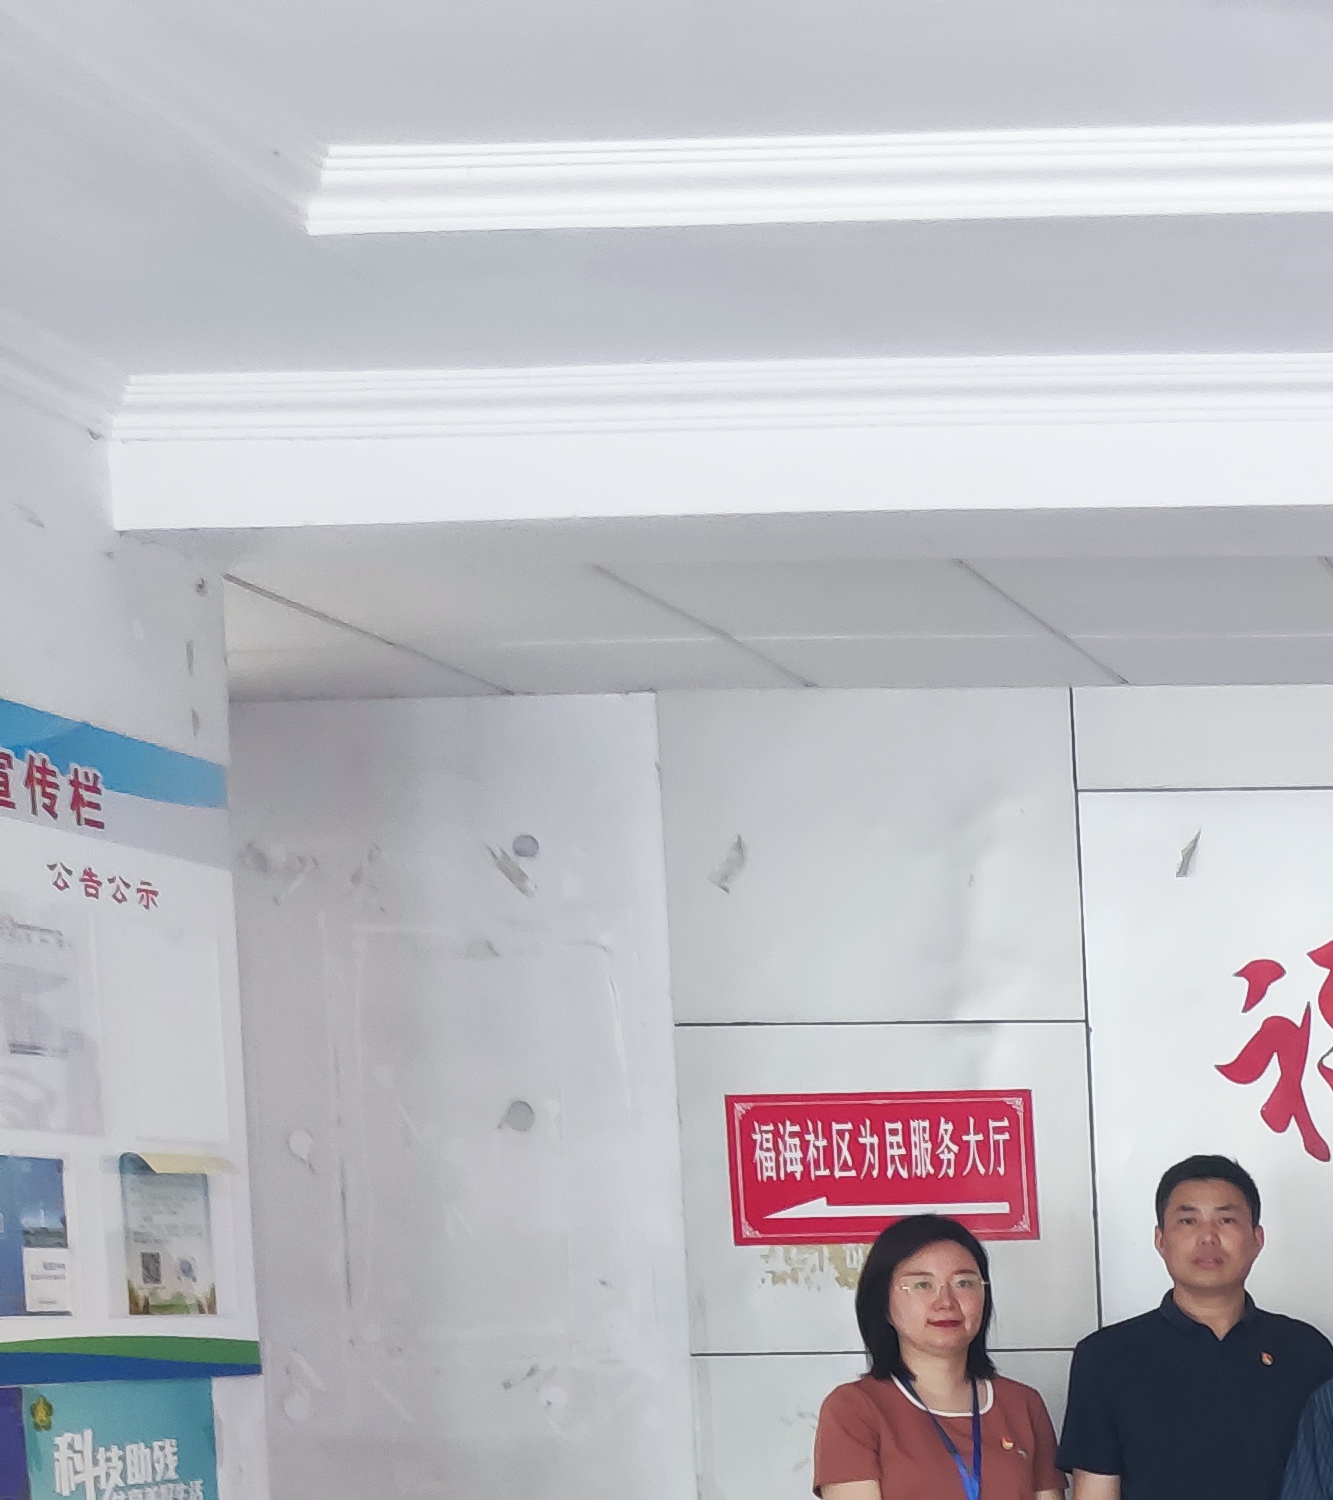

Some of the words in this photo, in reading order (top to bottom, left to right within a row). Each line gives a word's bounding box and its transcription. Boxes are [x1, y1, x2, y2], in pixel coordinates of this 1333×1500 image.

[46, 861, 159, 910] 公告公示
[751, 1116, 1011, 1182] 福海社区为民服务大厅
